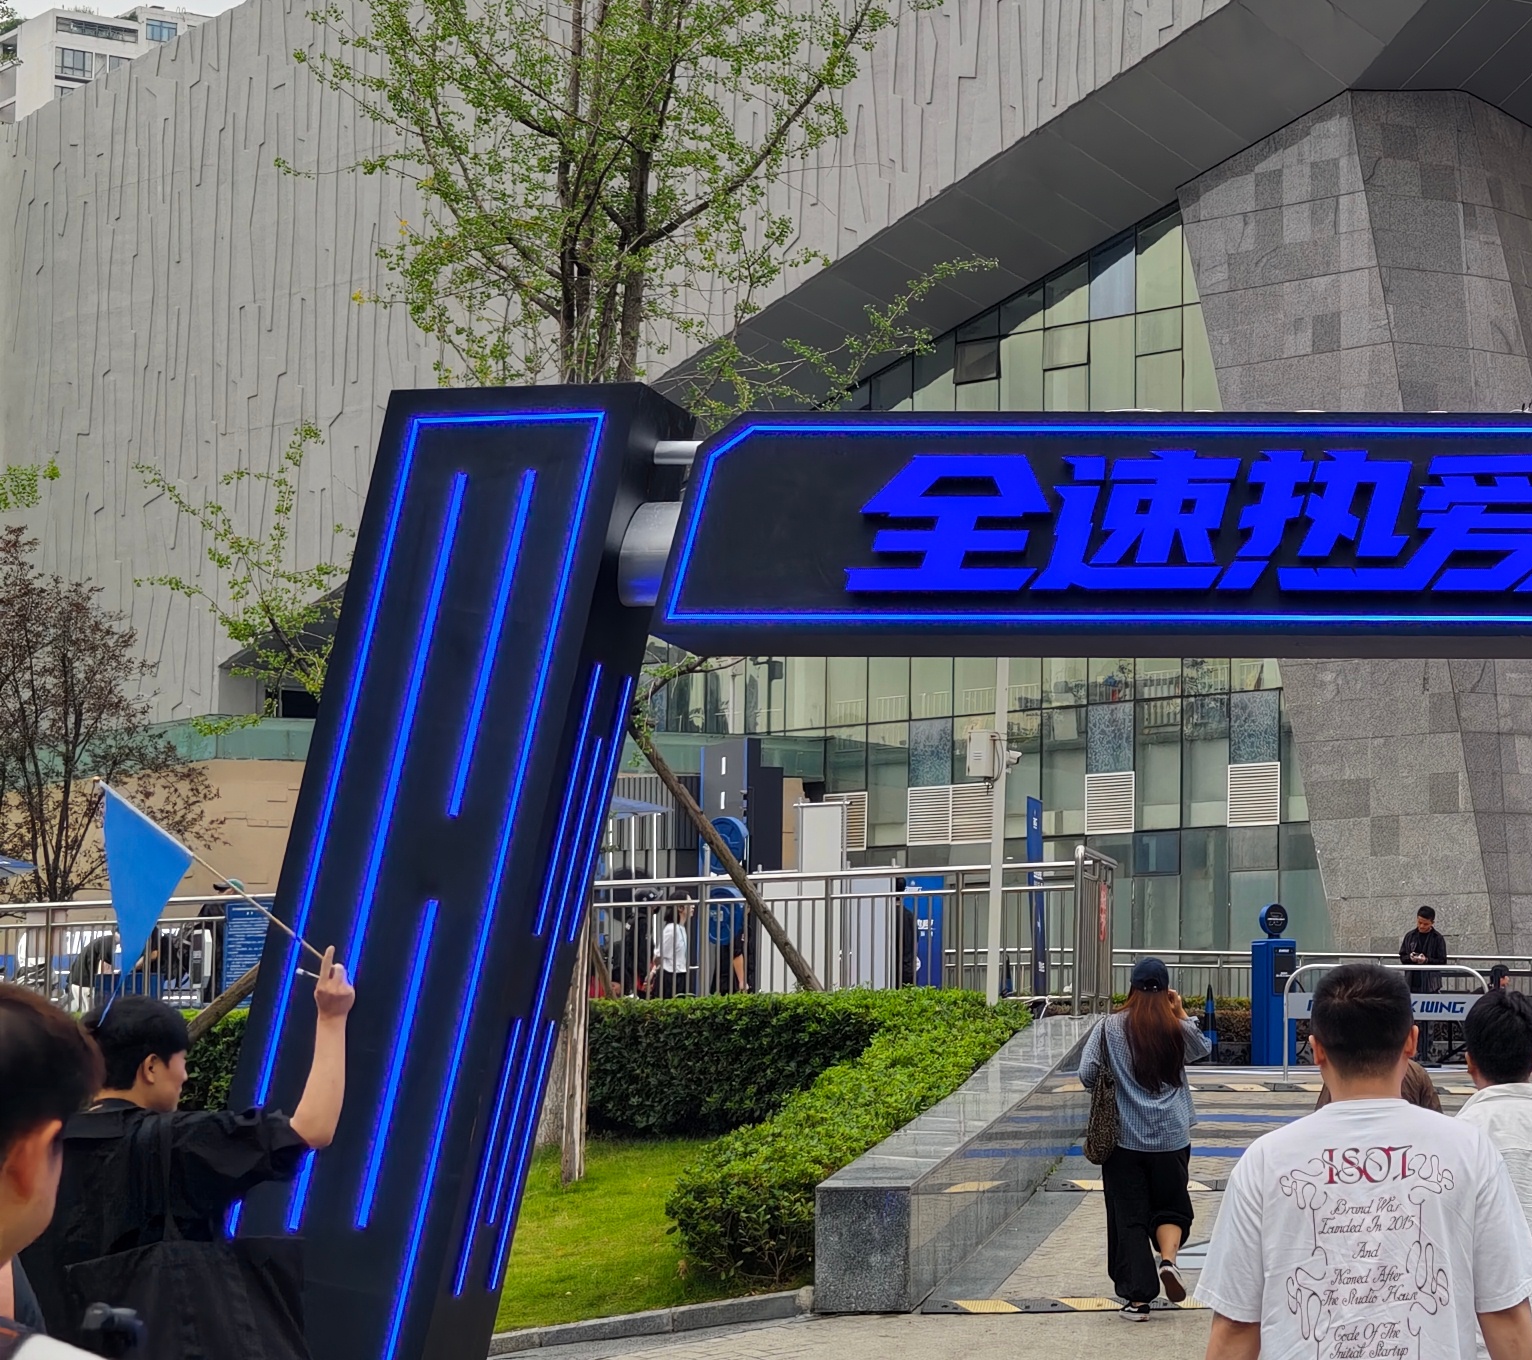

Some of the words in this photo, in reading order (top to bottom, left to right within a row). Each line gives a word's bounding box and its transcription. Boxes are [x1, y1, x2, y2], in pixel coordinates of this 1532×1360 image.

[1420, 1000, 1466, 1014] WING
[1330, 1198, 1372, 1216] Brand
[1387, 1215, 1416, 1231] 2015
[1352, 1242, 1382, 1259] And
[1372, 1265, 1403, 1290] After
[1321, 1289, 1339, 1306] The
[1364, 1322, 1381, 1346] Of
[1381, 1321, 1401, 1339] The
